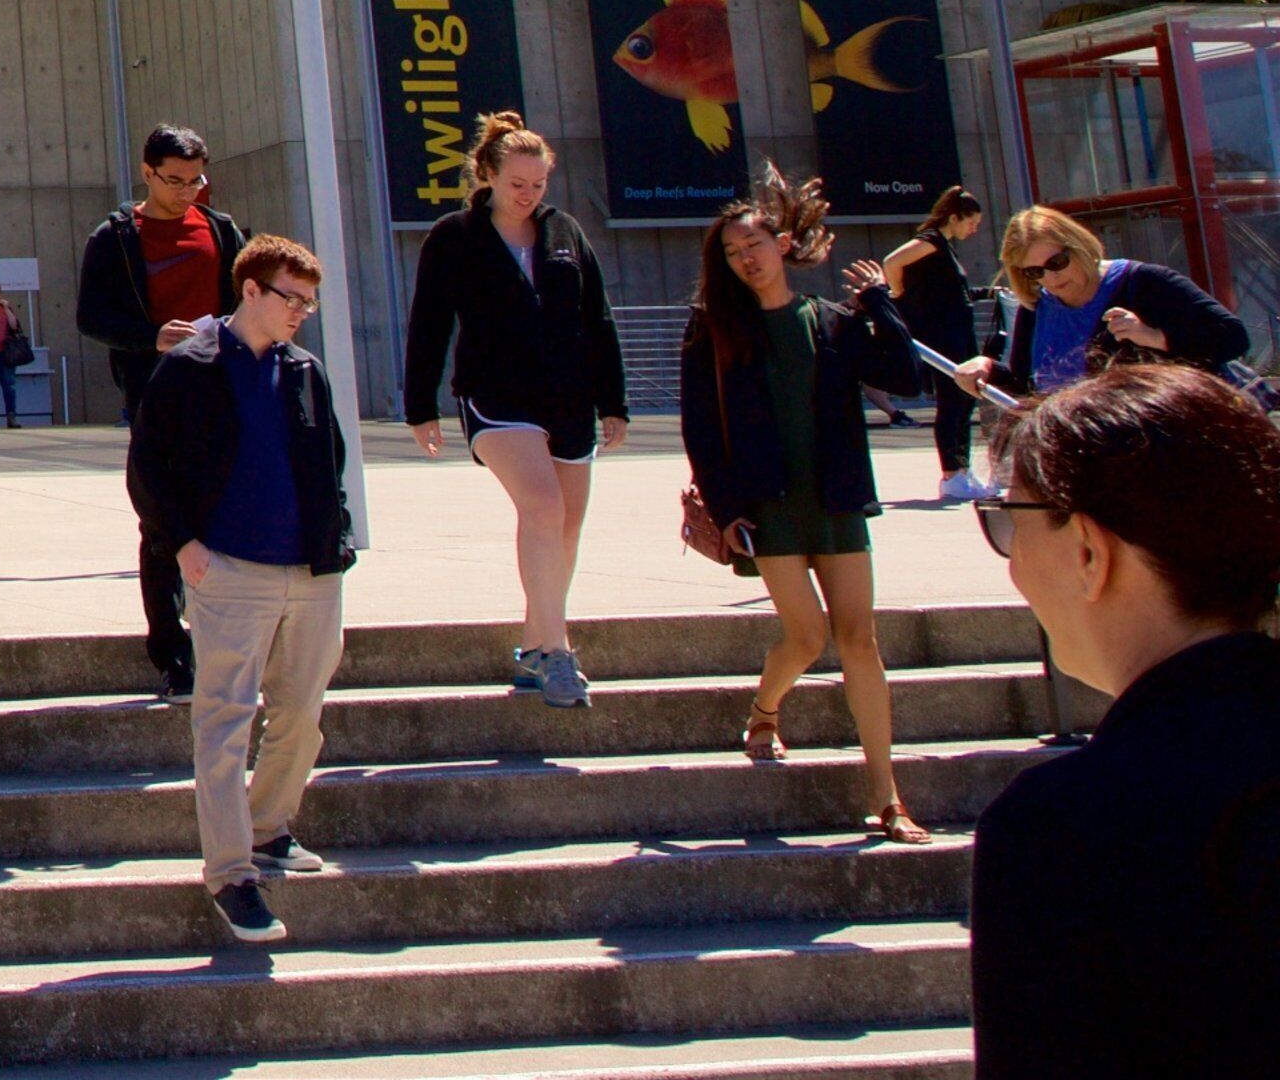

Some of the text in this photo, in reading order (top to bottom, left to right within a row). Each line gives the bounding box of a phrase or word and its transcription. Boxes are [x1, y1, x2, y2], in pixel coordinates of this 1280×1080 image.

[624, 185, 735, 201] Deep Reefs Revealed
[864, 180, 924, 196] Now Open
